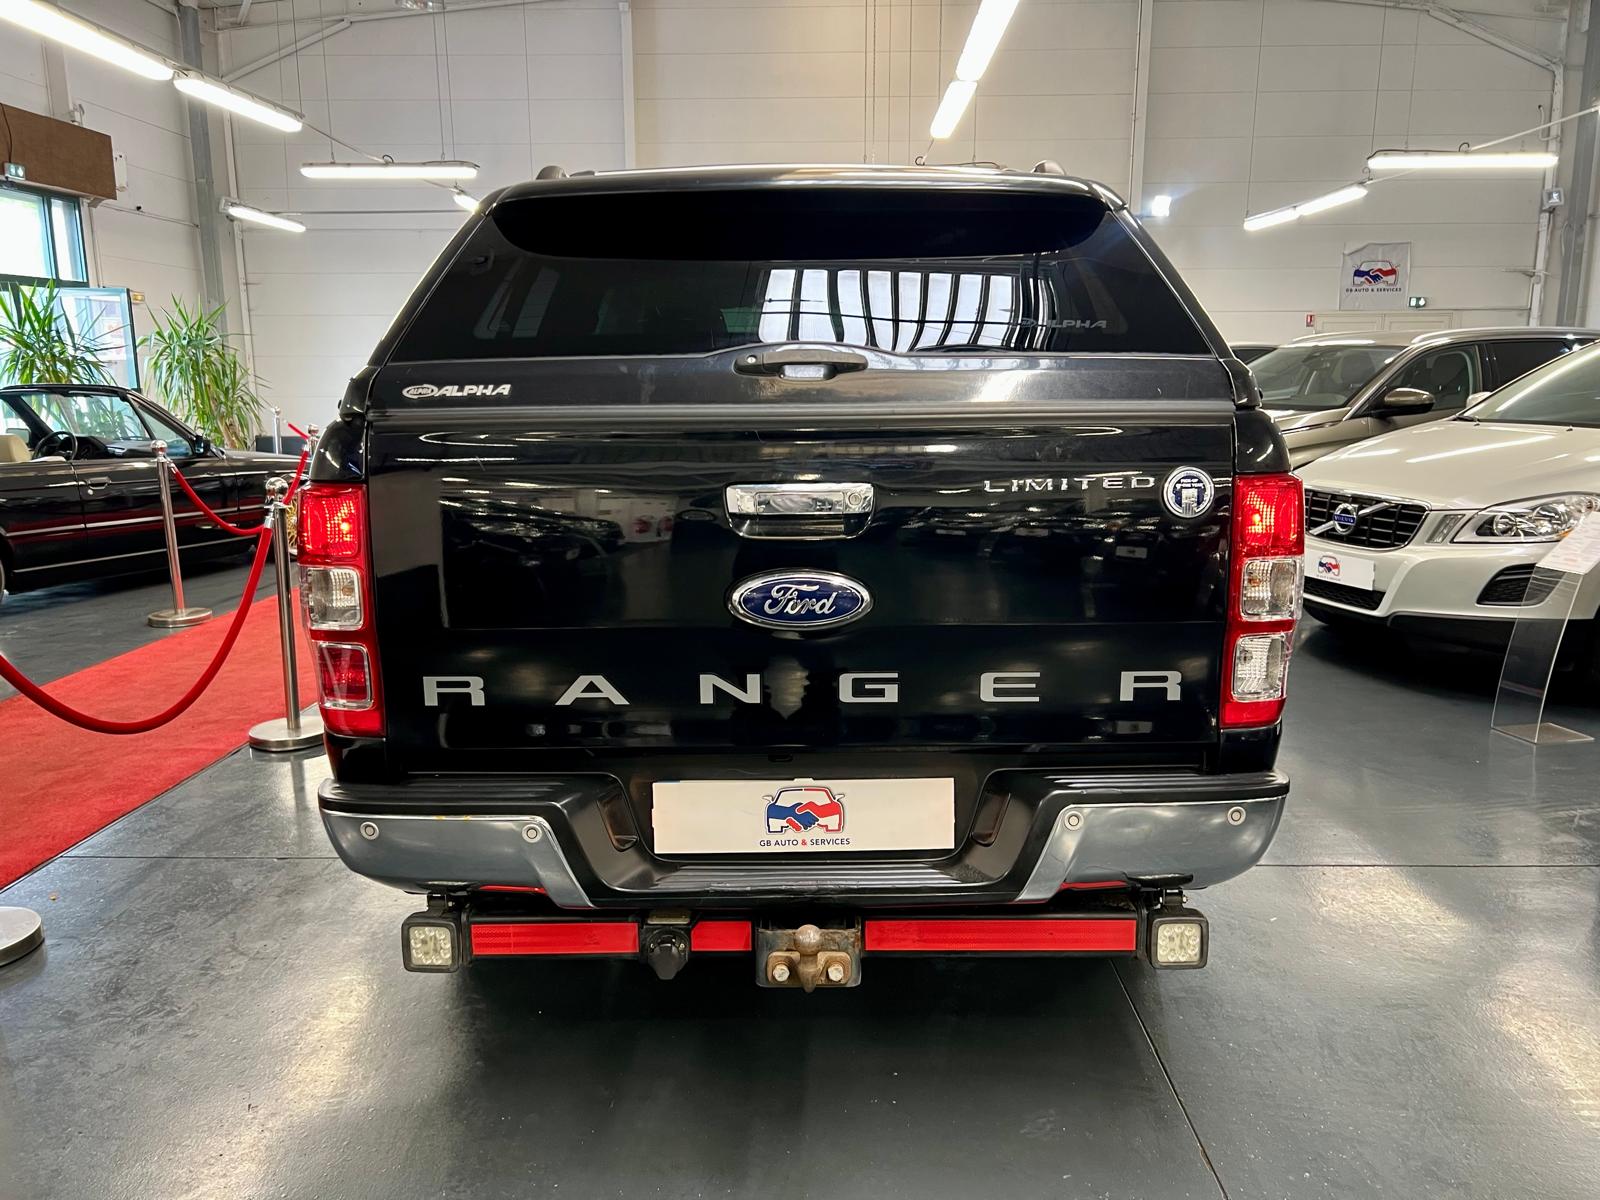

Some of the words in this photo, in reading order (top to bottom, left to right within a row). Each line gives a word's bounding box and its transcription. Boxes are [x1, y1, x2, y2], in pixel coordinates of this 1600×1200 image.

[434, 384, 511, 397] ALPHA
[984, 477, 1155, 492] LIMITED
[763, 584, 838, 615] Ford
[422, 670, 1183, 707] RANGER
[760, 839, 772, 847] GB
[774, 839, 799, 847] AUTO
[801, 838, 807, 846] &
[810, 837, 851, 846] SERVICES
